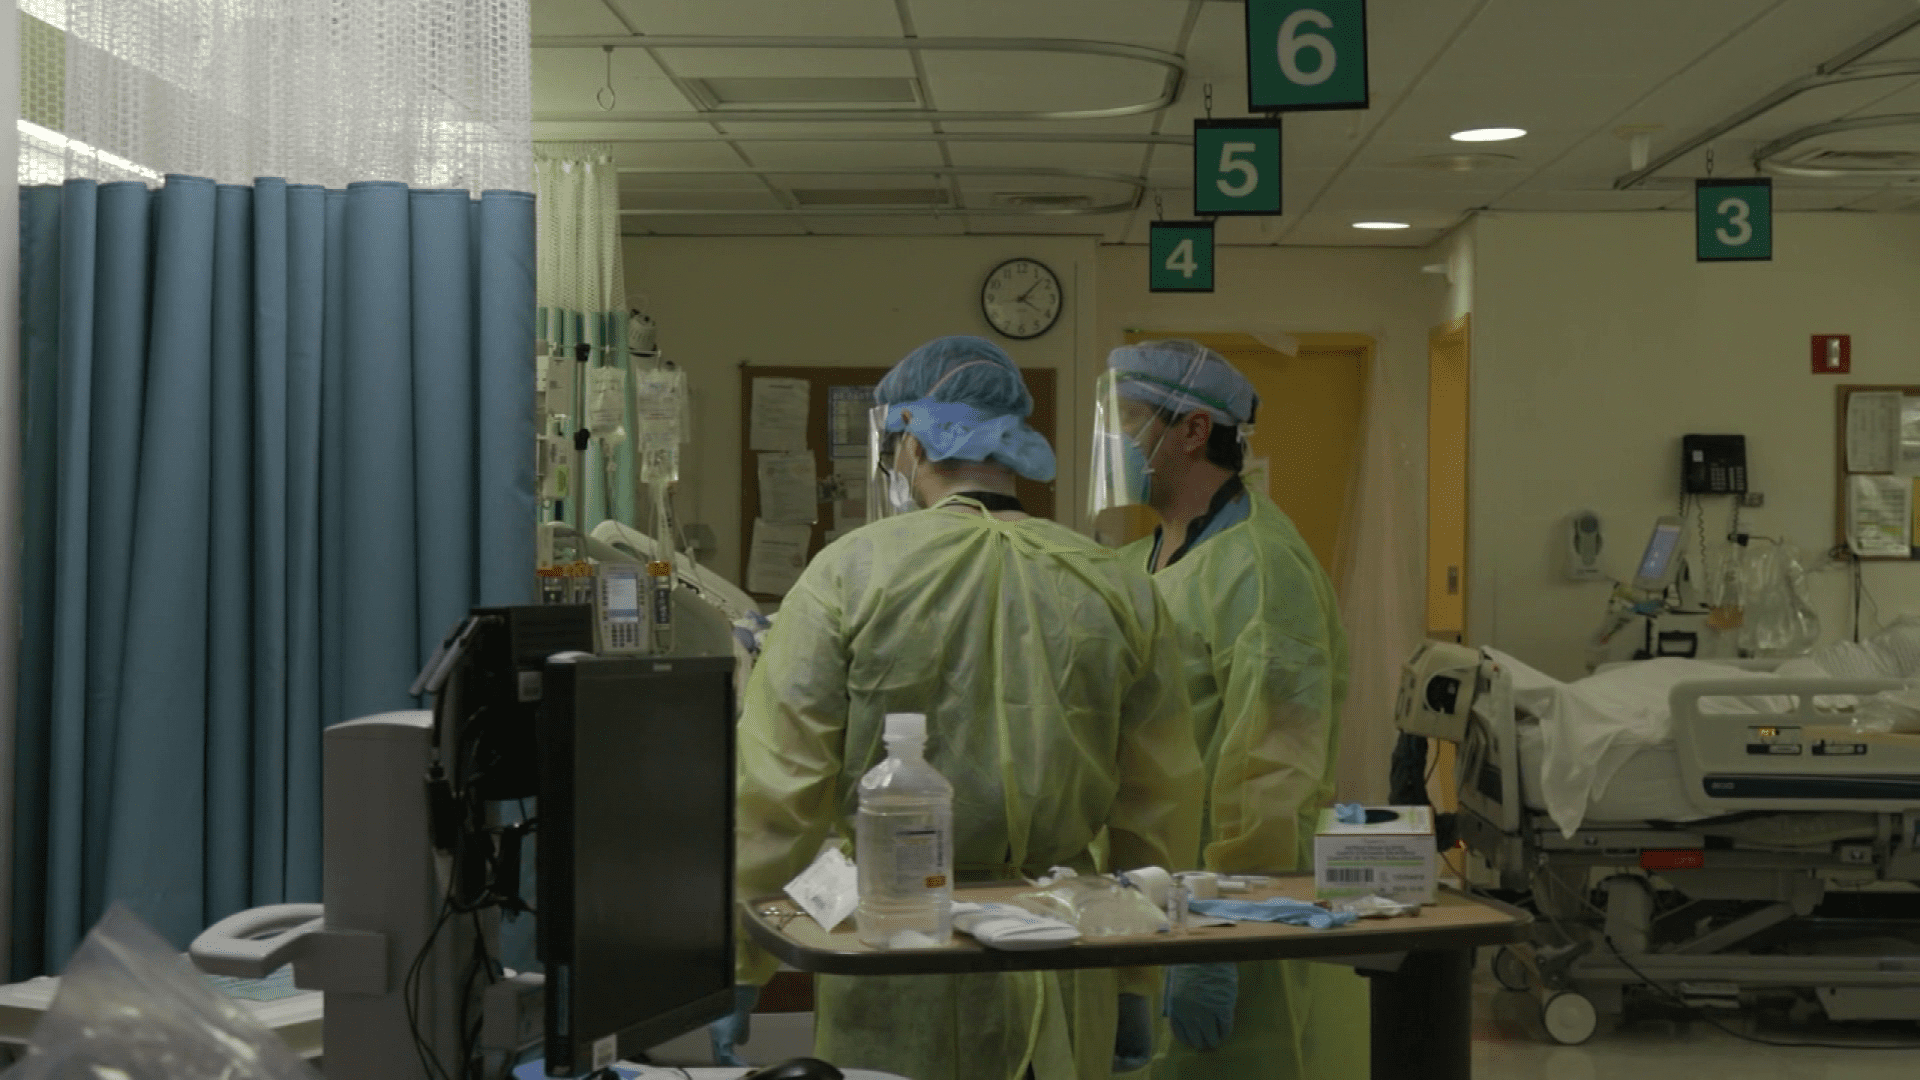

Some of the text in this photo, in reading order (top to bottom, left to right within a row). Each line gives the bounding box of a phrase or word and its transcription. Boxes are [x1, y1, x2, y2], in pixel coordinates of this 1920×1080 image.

[1277, 8, 1337, 86] 6
[1216, 142, 1259, 198] 5
[1715, 197, 1753, 246] 3
[1165, 239, 1198, 279] 4
[1003, 268, 1012, 279] 11
[1016, 263, 1028, 274] 12
[1033, 268, 1039, 279] 1
[1044, 279, 1052, 290] 2
[1049, 293, 1056, 304] 3
[1003, 320, 1011, 331] 7
[1018, 323, 1026, 336] 6
[1033, 320, 1040, 331] 5
